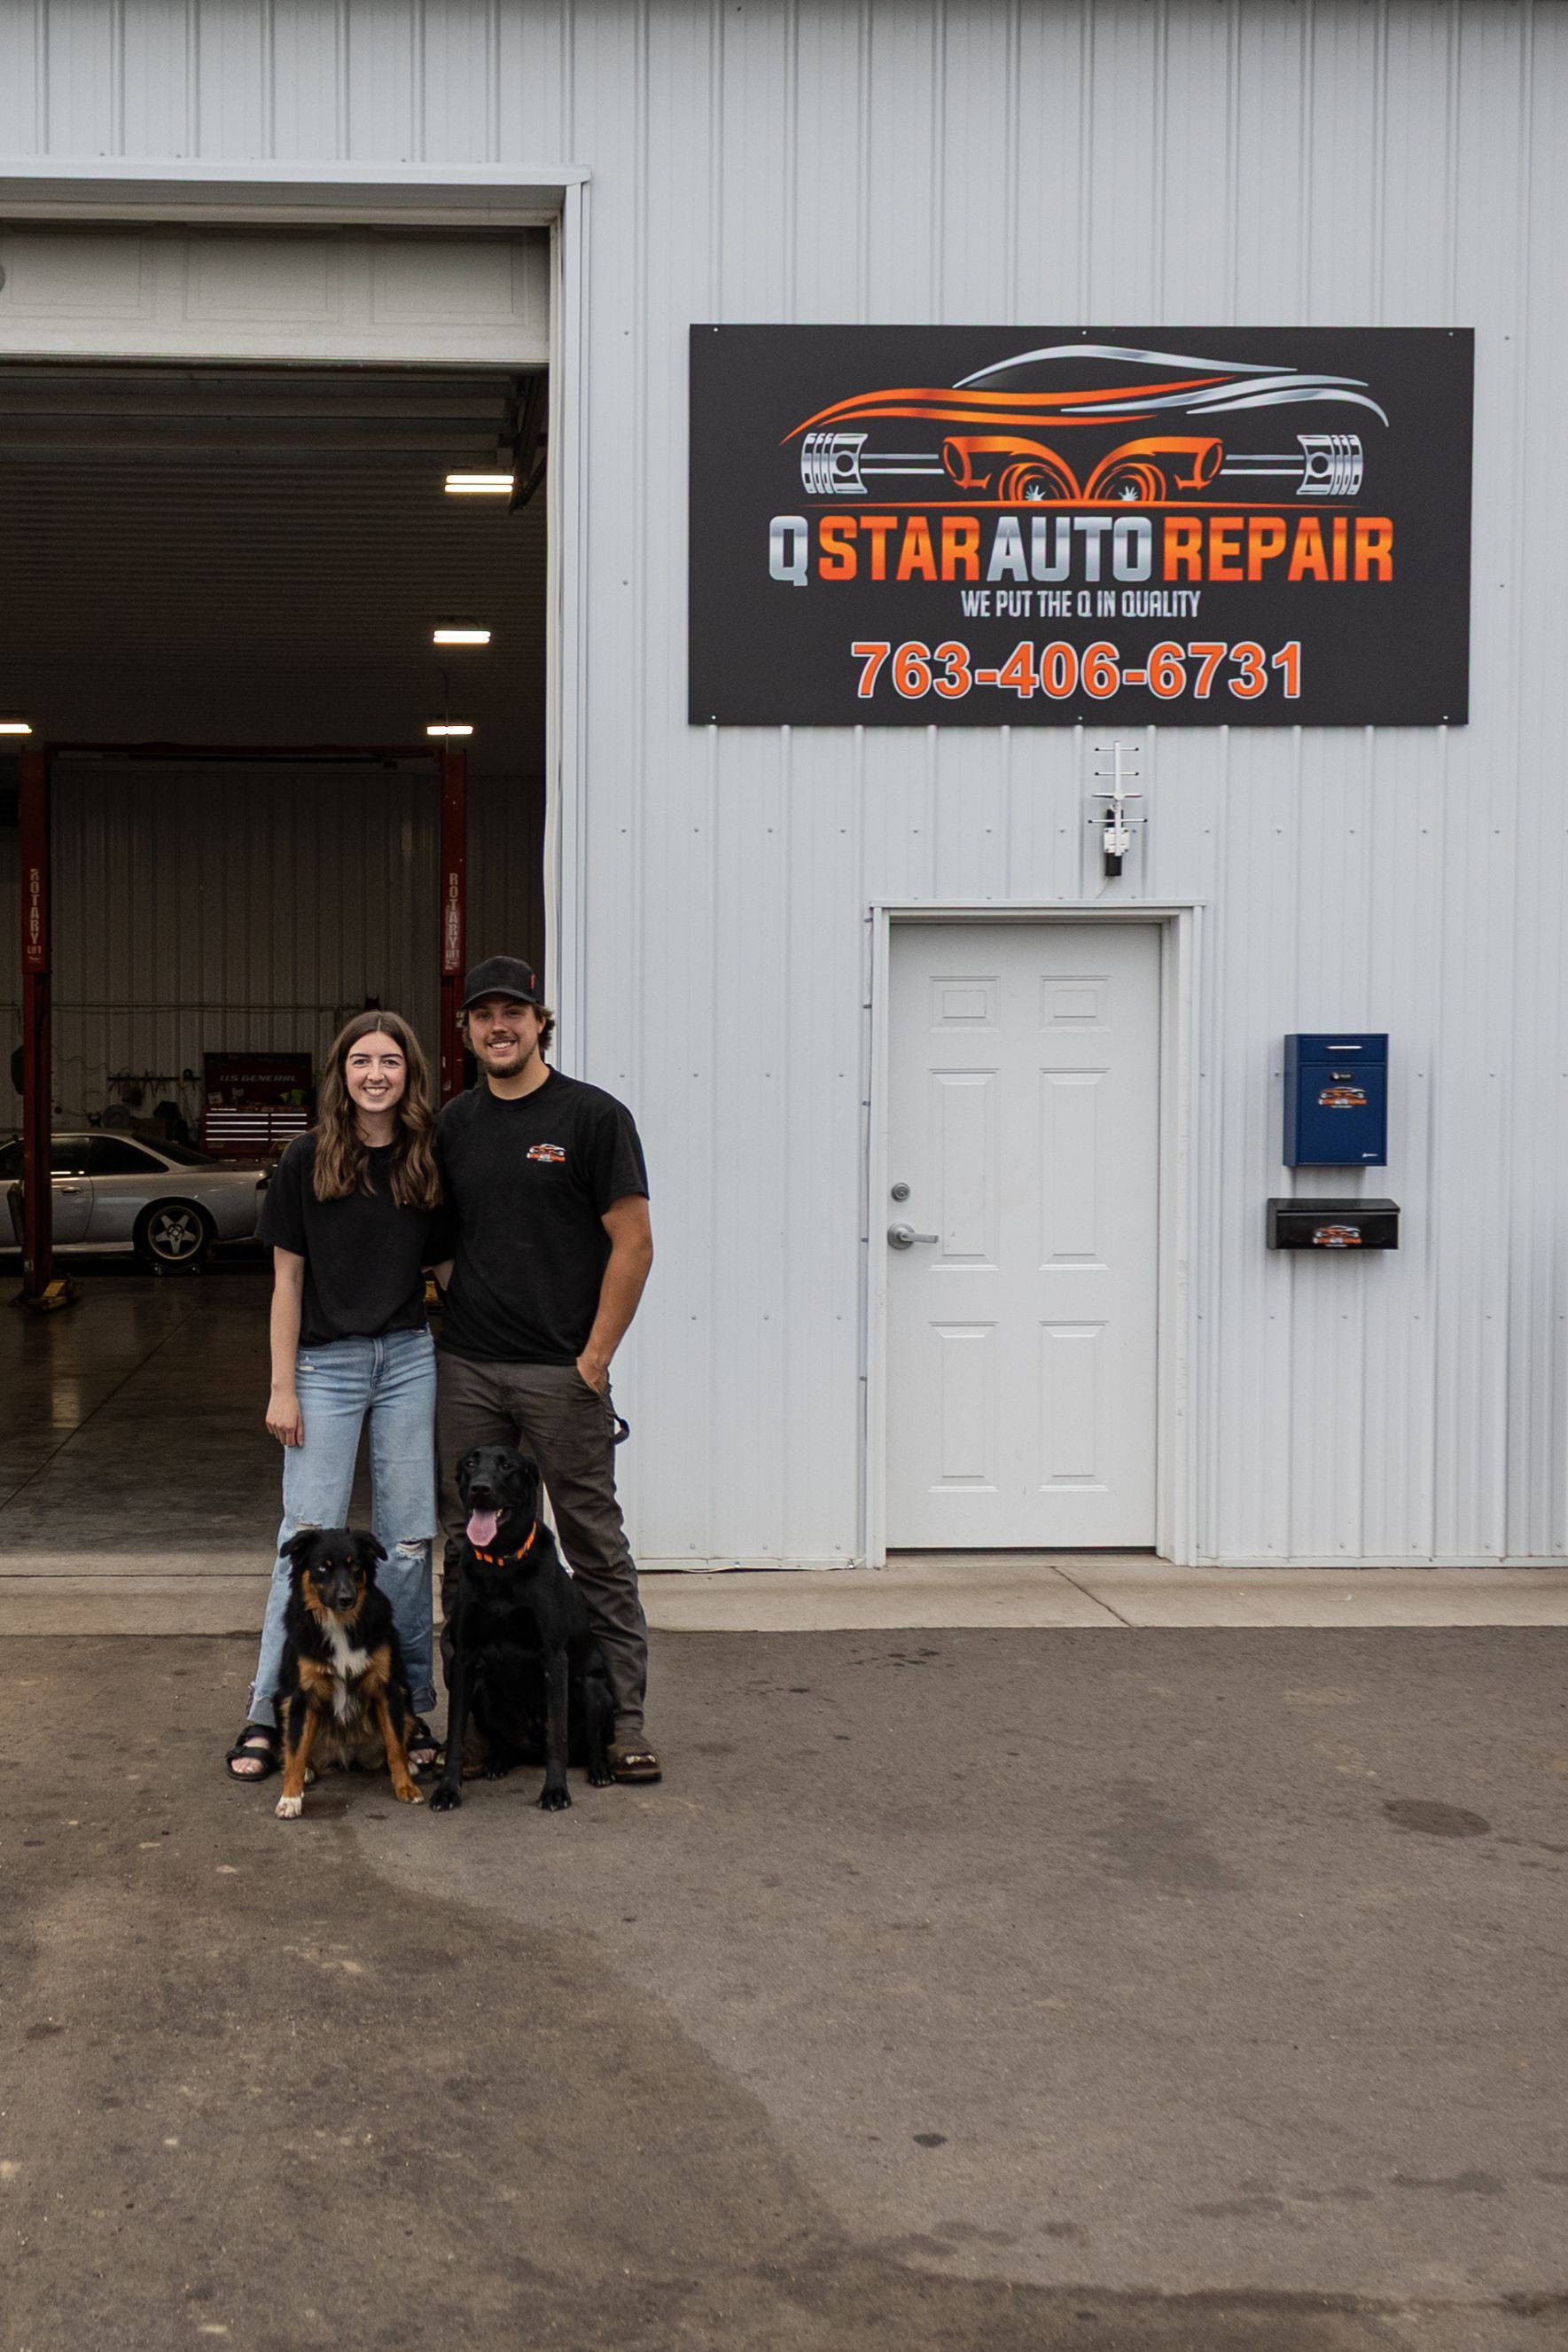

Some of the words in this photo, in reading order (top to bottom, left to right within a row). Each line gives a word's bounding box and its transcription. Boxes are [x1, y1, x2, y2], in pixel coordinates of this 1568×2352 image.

[768, 515, 808, 587] Q
[818, 515, 980, 581] STAR
[986, 516, 1152, 582] AUTO
[1163, 516, 1394, 582] REPAIR
[960, 590, 991, 618] WE
[995, 590, 1033, 618] PUT
[1037, 590, 1073, 618] THE
[1077, 590, 1092, 618] Q
[1096, 590, 1116, 618] IN
[1121, 590, 1201, 618] QUALITY
[851, 640, 1301, 699] 763-406-6731
[29, 868, 40, 945] ROTARY
[449, 872, 459, 949] ROTARY
